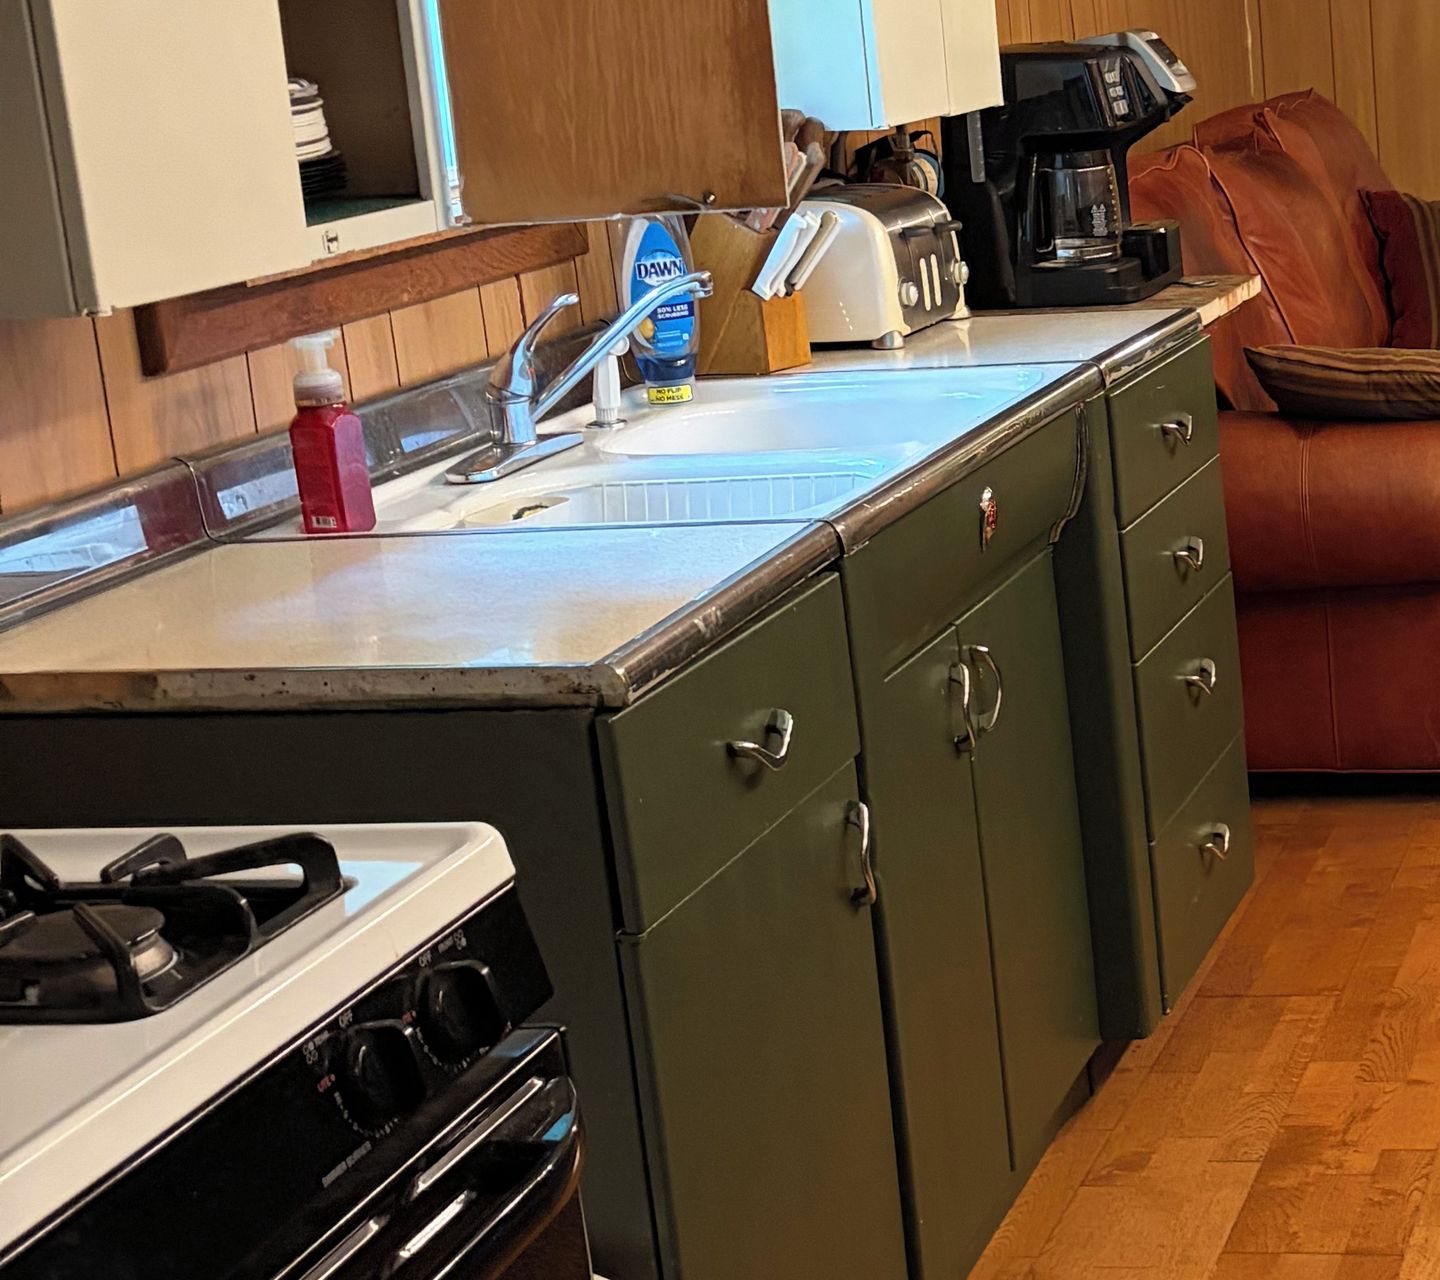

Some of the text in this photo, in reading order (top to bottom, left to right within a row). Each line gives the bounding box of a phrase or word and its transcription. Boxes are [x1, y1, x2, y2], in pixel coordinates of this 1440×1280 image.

[637, 260, 682, 279] DAWN
[418, 950, 432, 968] OFF
[338, 1009, 353, 1028] OFF
